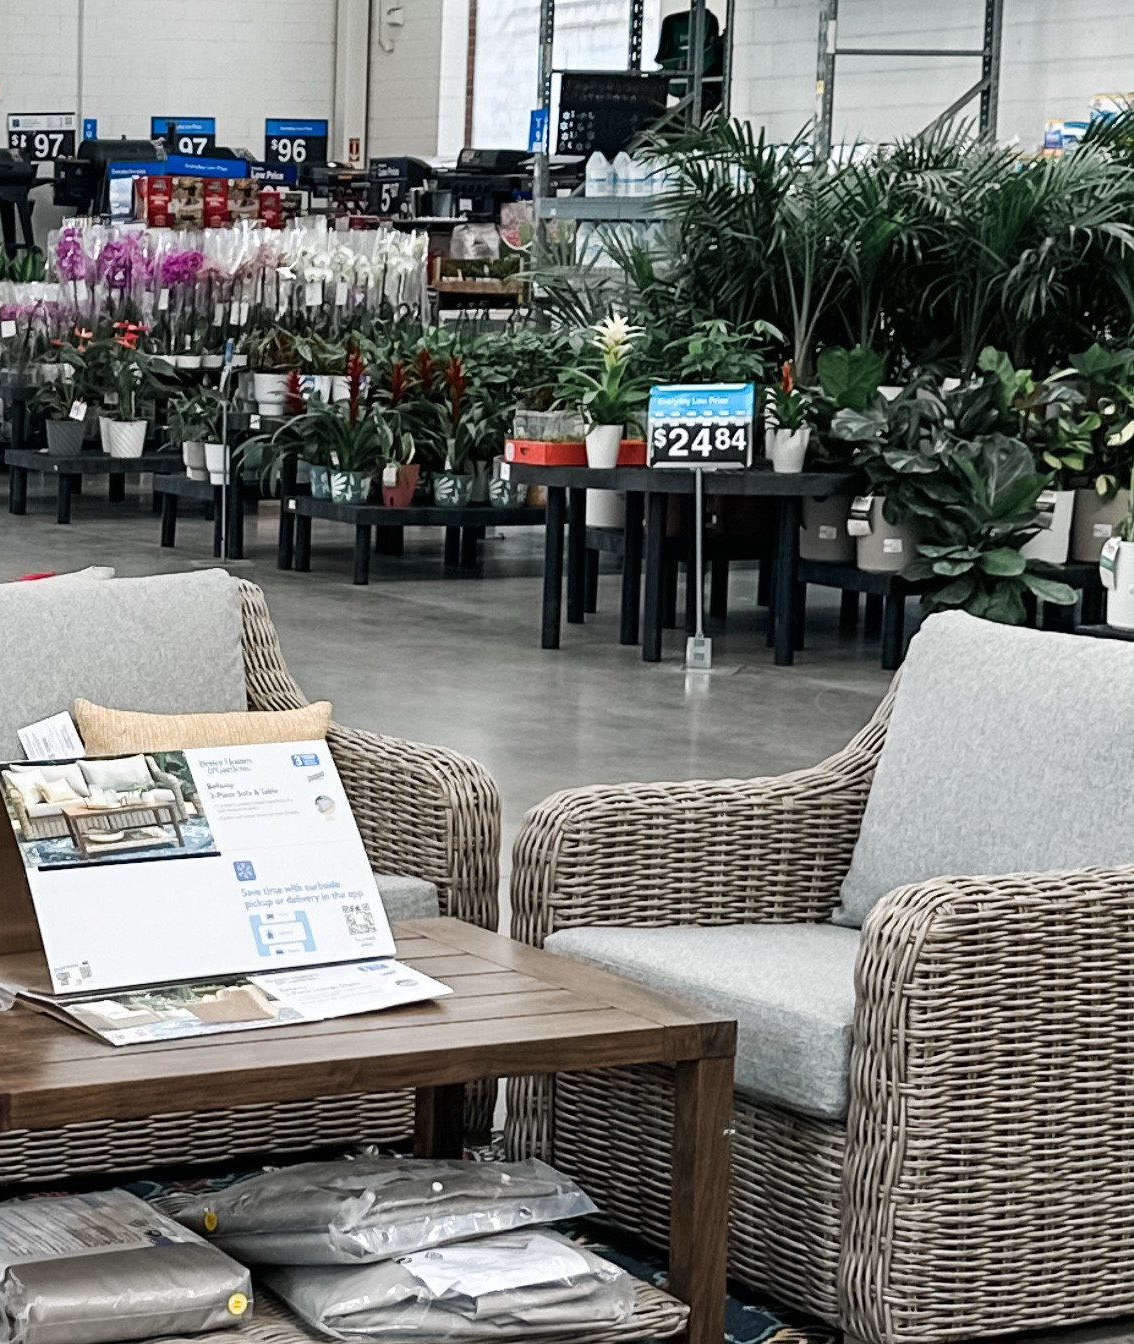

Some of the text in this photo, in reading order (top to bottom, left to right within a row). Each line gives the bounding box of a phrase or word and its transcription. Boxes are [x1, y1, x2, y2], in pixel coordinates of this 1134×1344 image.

[270, 138, 307, 163] $96
[241, 887, 261, 898] Save
[263, 886, 282, 895] time
[284, 883, 303, 893] with
[286, 894, 320, 905] delivery
